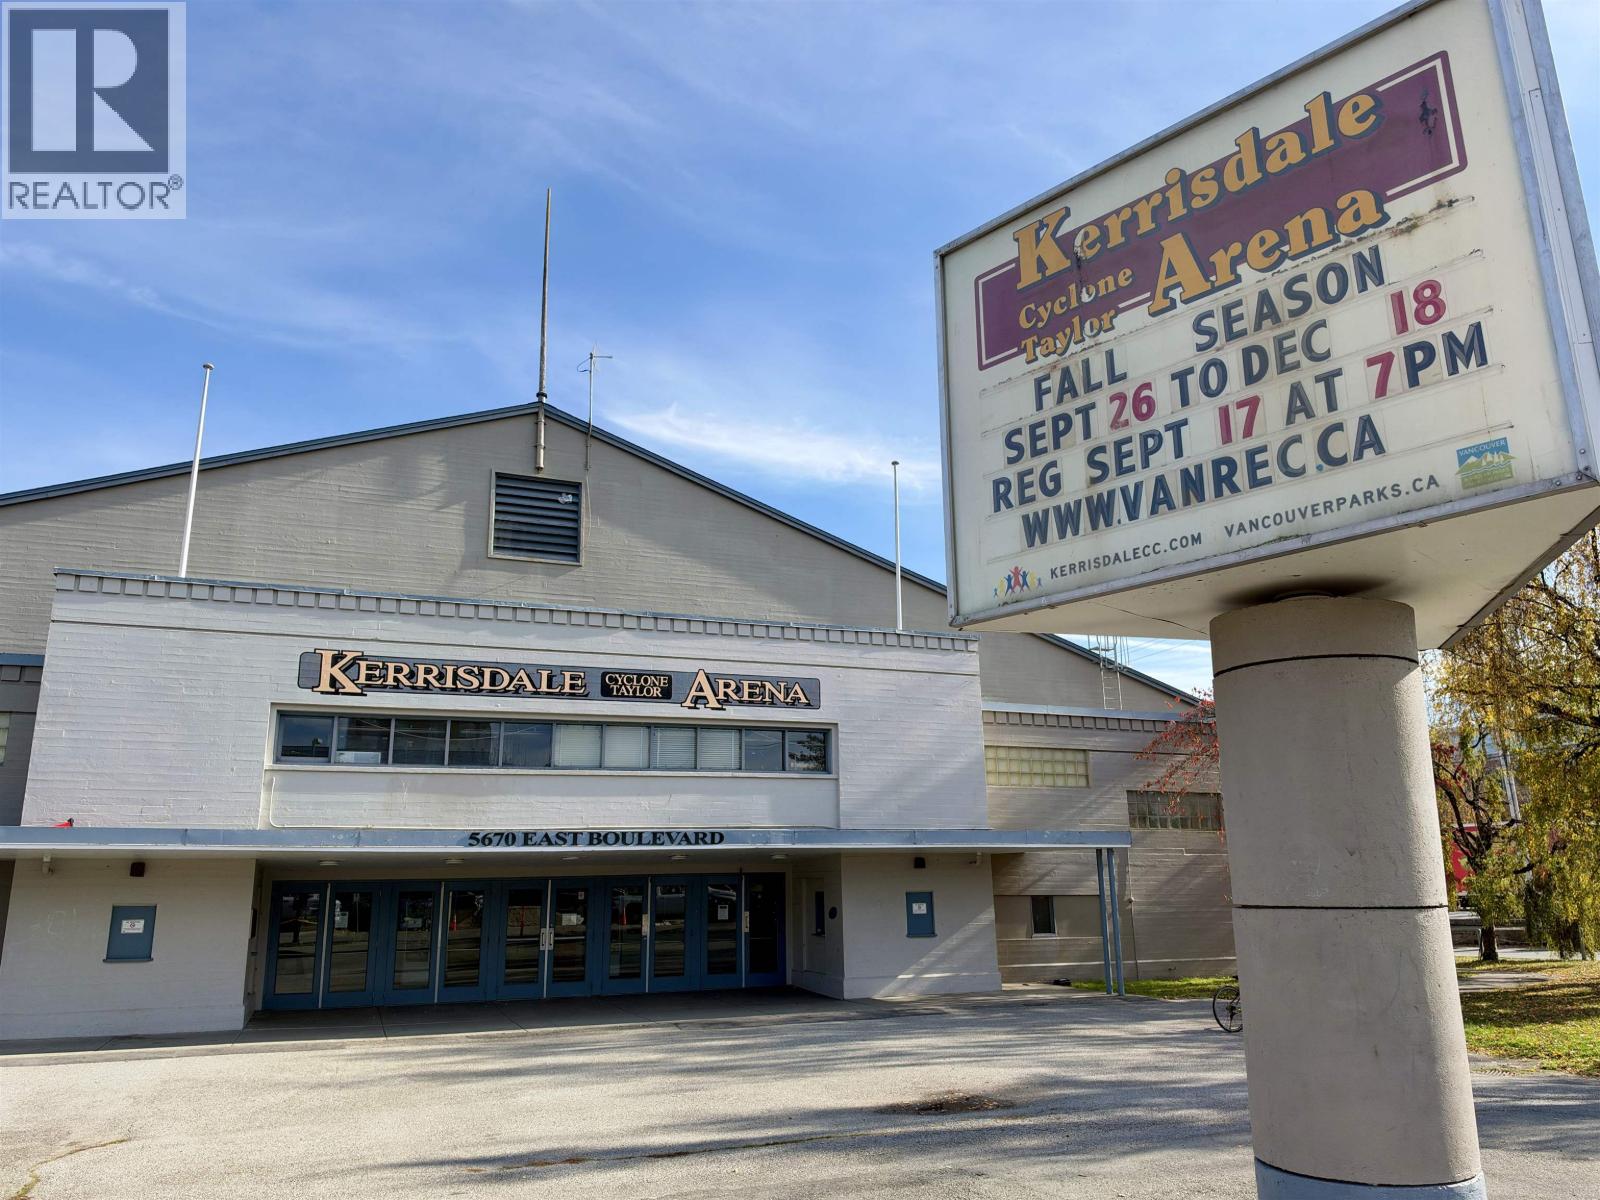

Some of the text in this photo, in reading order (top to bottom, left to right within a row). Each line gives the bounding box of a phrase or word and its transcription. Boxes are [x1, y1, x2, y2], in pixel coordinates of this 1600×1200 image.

[1012, 91, 1382, 290] Kerrisdale
[1148, 189, 1391, 317] Arena
[1018, 266, 1134, 330] Cyclone
[1033, 244, 1386, 412] FALL SEASON
[1020, 308, 1120, 364] Taylor
[1004, 279, 1447, 466] SEPT 26 TO DEC 18
[991, 459, 1063, 514] REG
[1086, 417, 1189, 485] SEPT
[1217, 394, 1262, 446] 17
[1285, 367, 1344, 427] AT
[1458, 440, 1506, 456] VANCOUVER
[1021, 413, 1387, 549] WWW.VANREC.CA
[1224, 474, 1440, 538] VANCOUVERPARKS.CA
[1049, 532, 1203, 580] KERRISDALECC.COM
[312, 648, 813, 710] KERRISDALE ARENA
[604, 672, 669, 688] CYCLONE
[609, 684, 663, 698] TAYLOR
[467, 831, 725, 847] 5670 EAST BOULEVARD
